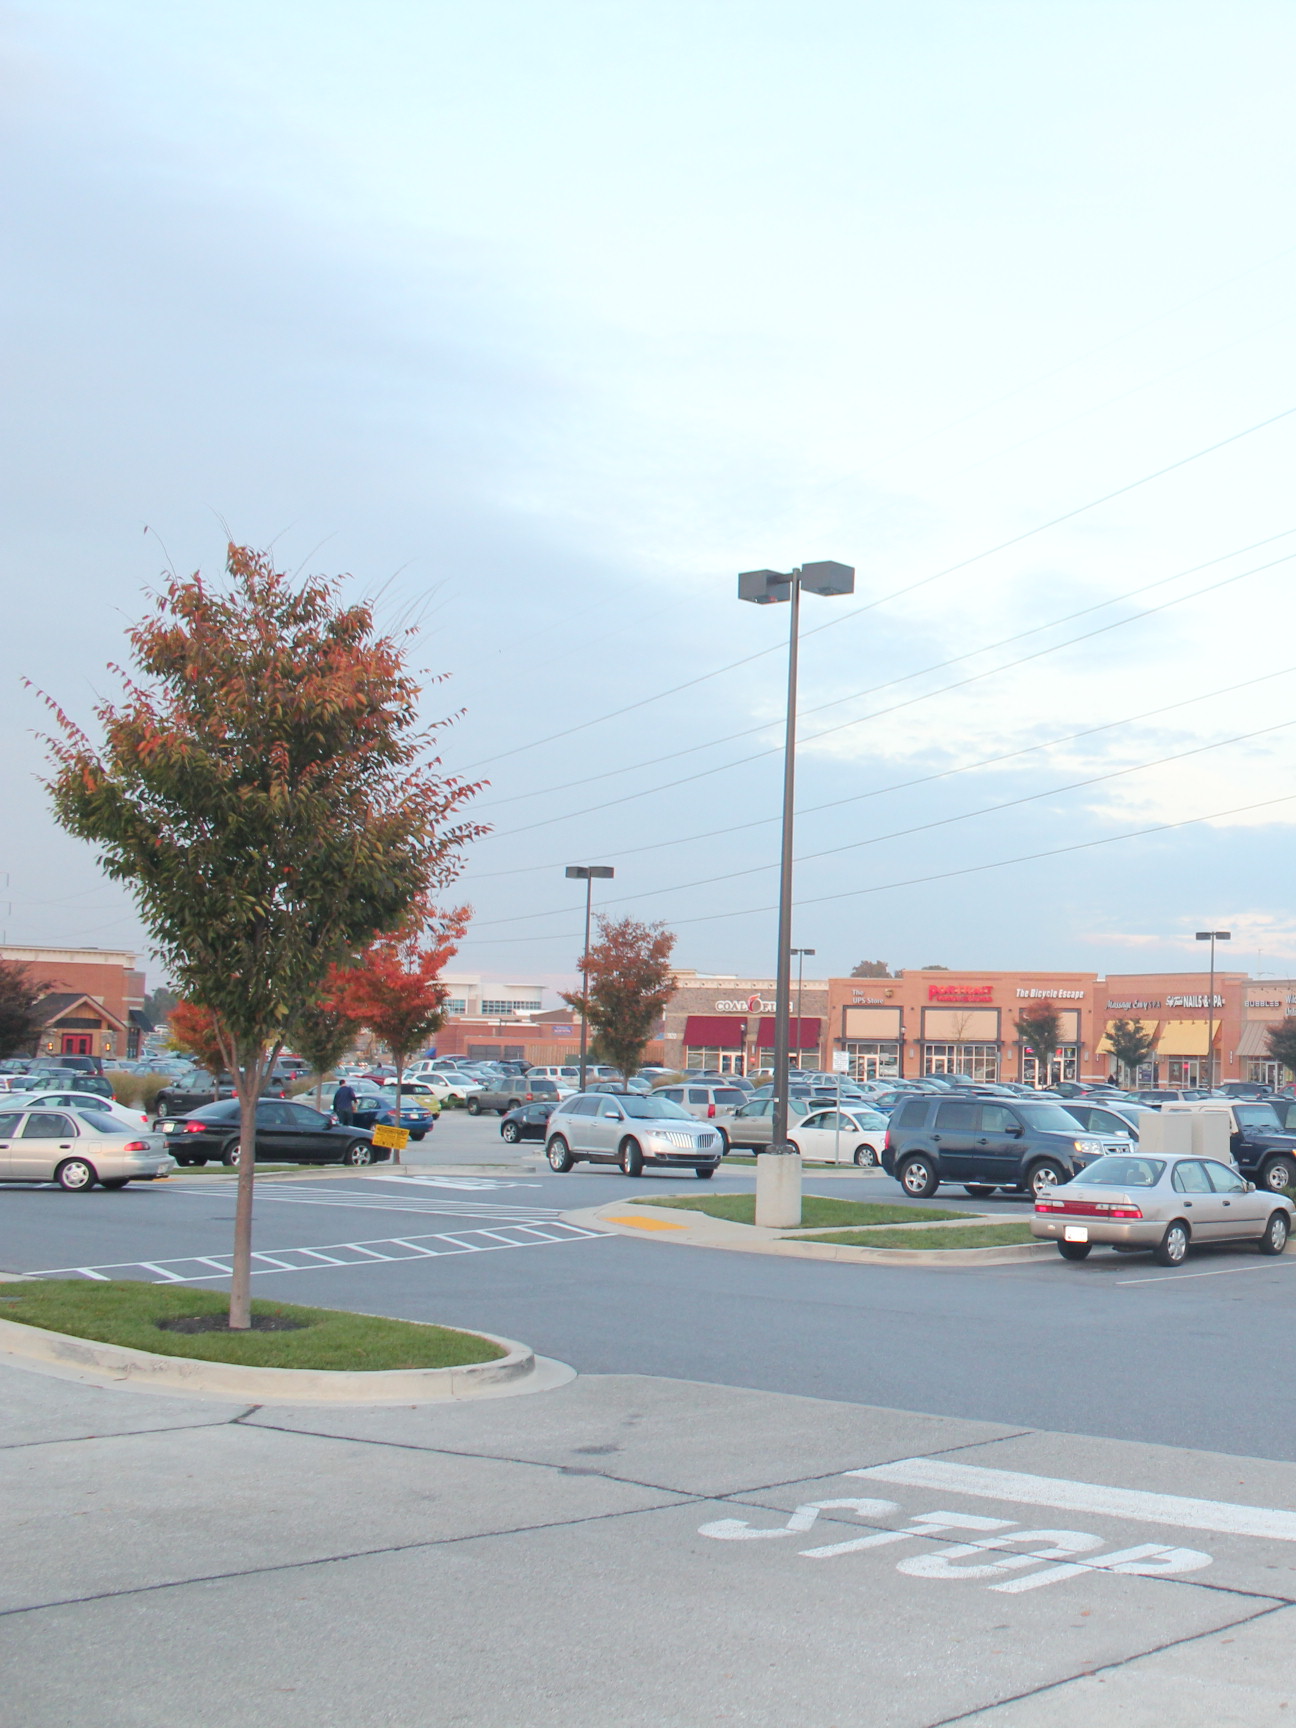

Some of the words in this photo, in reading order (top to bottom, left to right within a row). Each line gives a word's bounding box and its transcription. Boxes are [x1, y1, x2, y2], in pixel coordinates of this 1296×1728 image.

[852, 989, 864, 997] The
[1016, 988, 1029, 998] The
[1030, 988, 1057, 999] Bicycle
[1058, 989, 1084, 1000] Escape
[1285, 994, 1296, 1004] Wild
[715, 1000, 748, 1012] COAL
[867, 997, 884, 1005] Store
[1183, 995, 1202, 1008] NAILS
[1202, 995, 1209, 1008] &
[698, 1498, 1213, 1594] STOP
